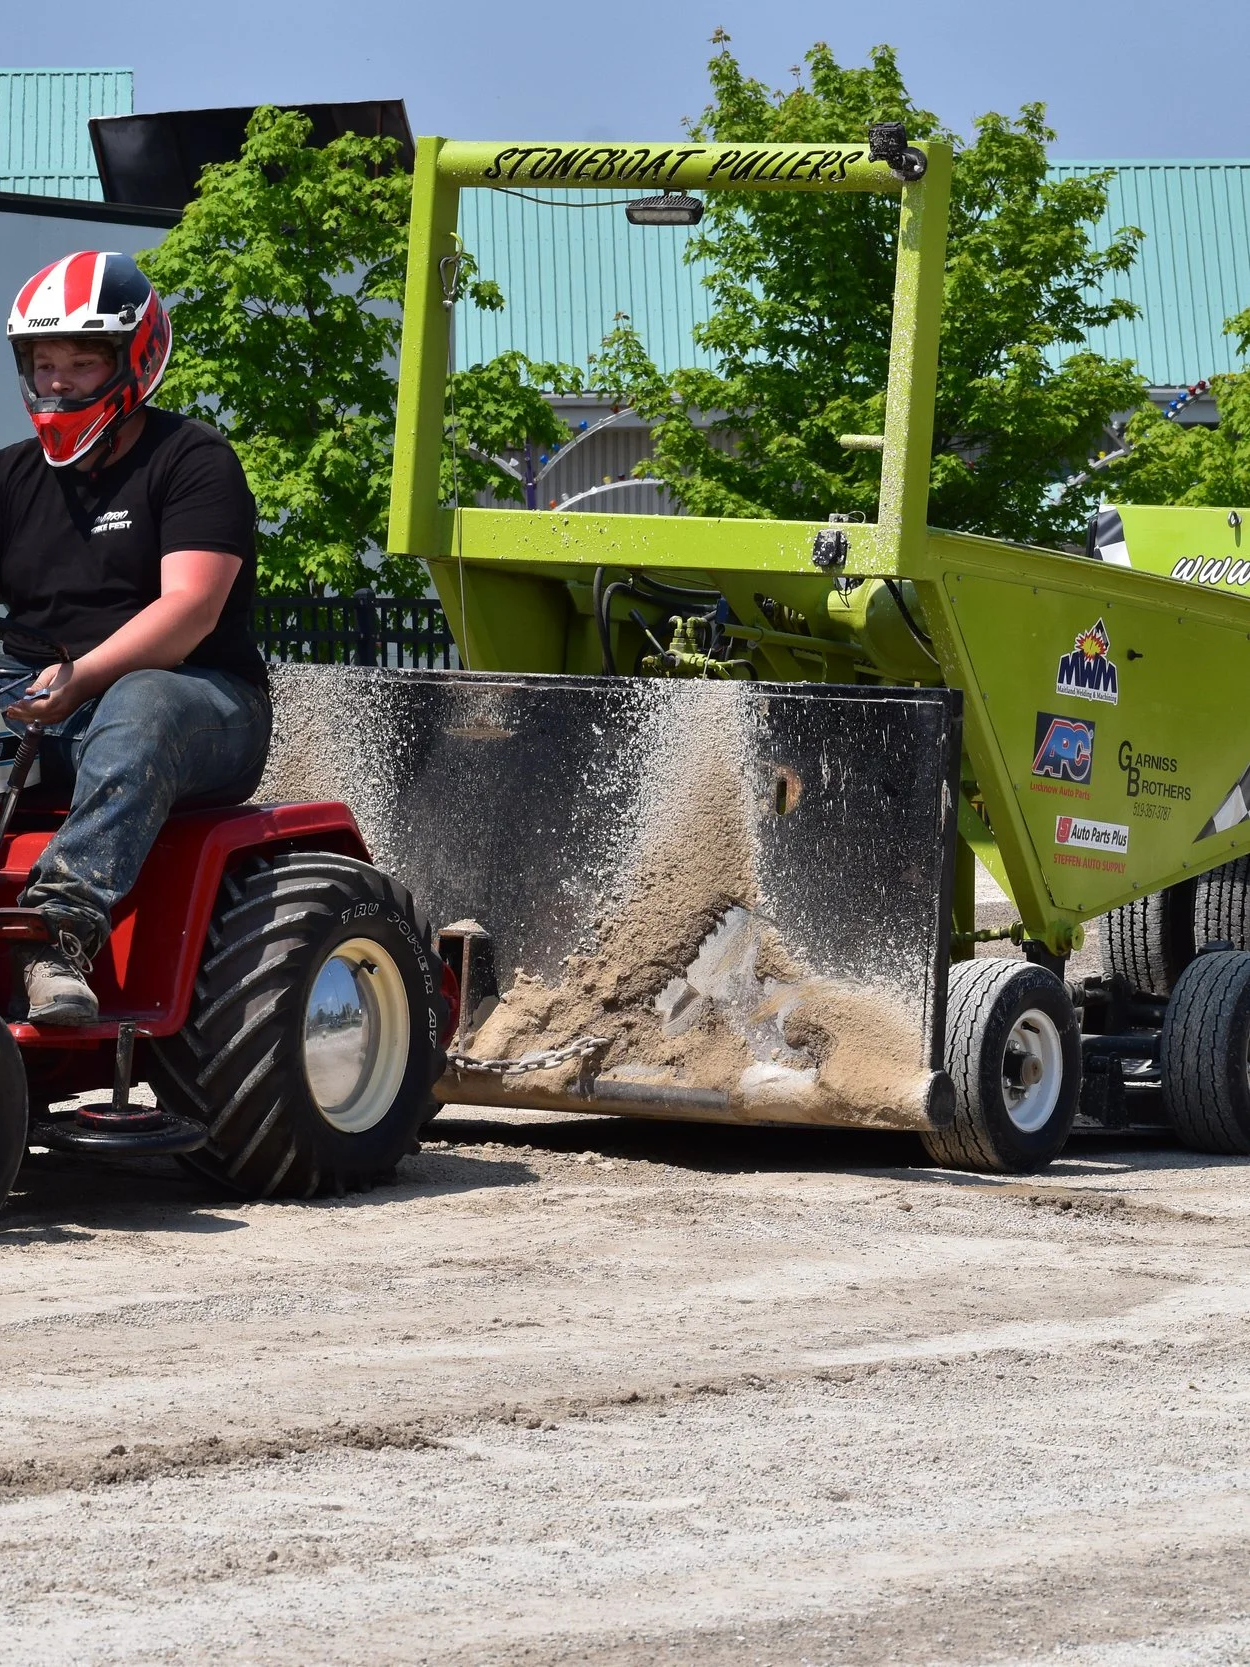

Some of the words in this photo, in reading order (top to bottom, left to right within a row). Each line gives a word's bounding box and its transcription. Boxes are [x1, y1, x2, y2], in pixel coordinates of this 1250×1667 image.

[484, 146, 706, 182] STONEBOAT
[709, 149, 865, 184] PULLERS
[28, 317, 60, 328] THOR
[108, 520, 132, 530] FEST
[1058, 650, 1117, 693] MWM
[1032, 718, 1091, 780] APC
[1118, 740, 1178, 773] GARNISS
[1030, 782, 1058, 794] Lucknow
[1059, 786, 1075, 797] Auto
[1075, 789, 1091, 800] Parts
[1127, 766, 1192, 801] BROTHERS
[1070, 824, 1091, 841] Auto
[1091, 827, 1111, 844] Parts
[1111, 829, 1127, 847] Plus
[1053, 853, 1082, 868] STEFFEN
[1081, 857, 1101, 871] AUTO
[1102, 860, 1127, 875] SUPPLY
[341, 902, 379, 925] TRU
[386, 911, 434, 995] POWER
